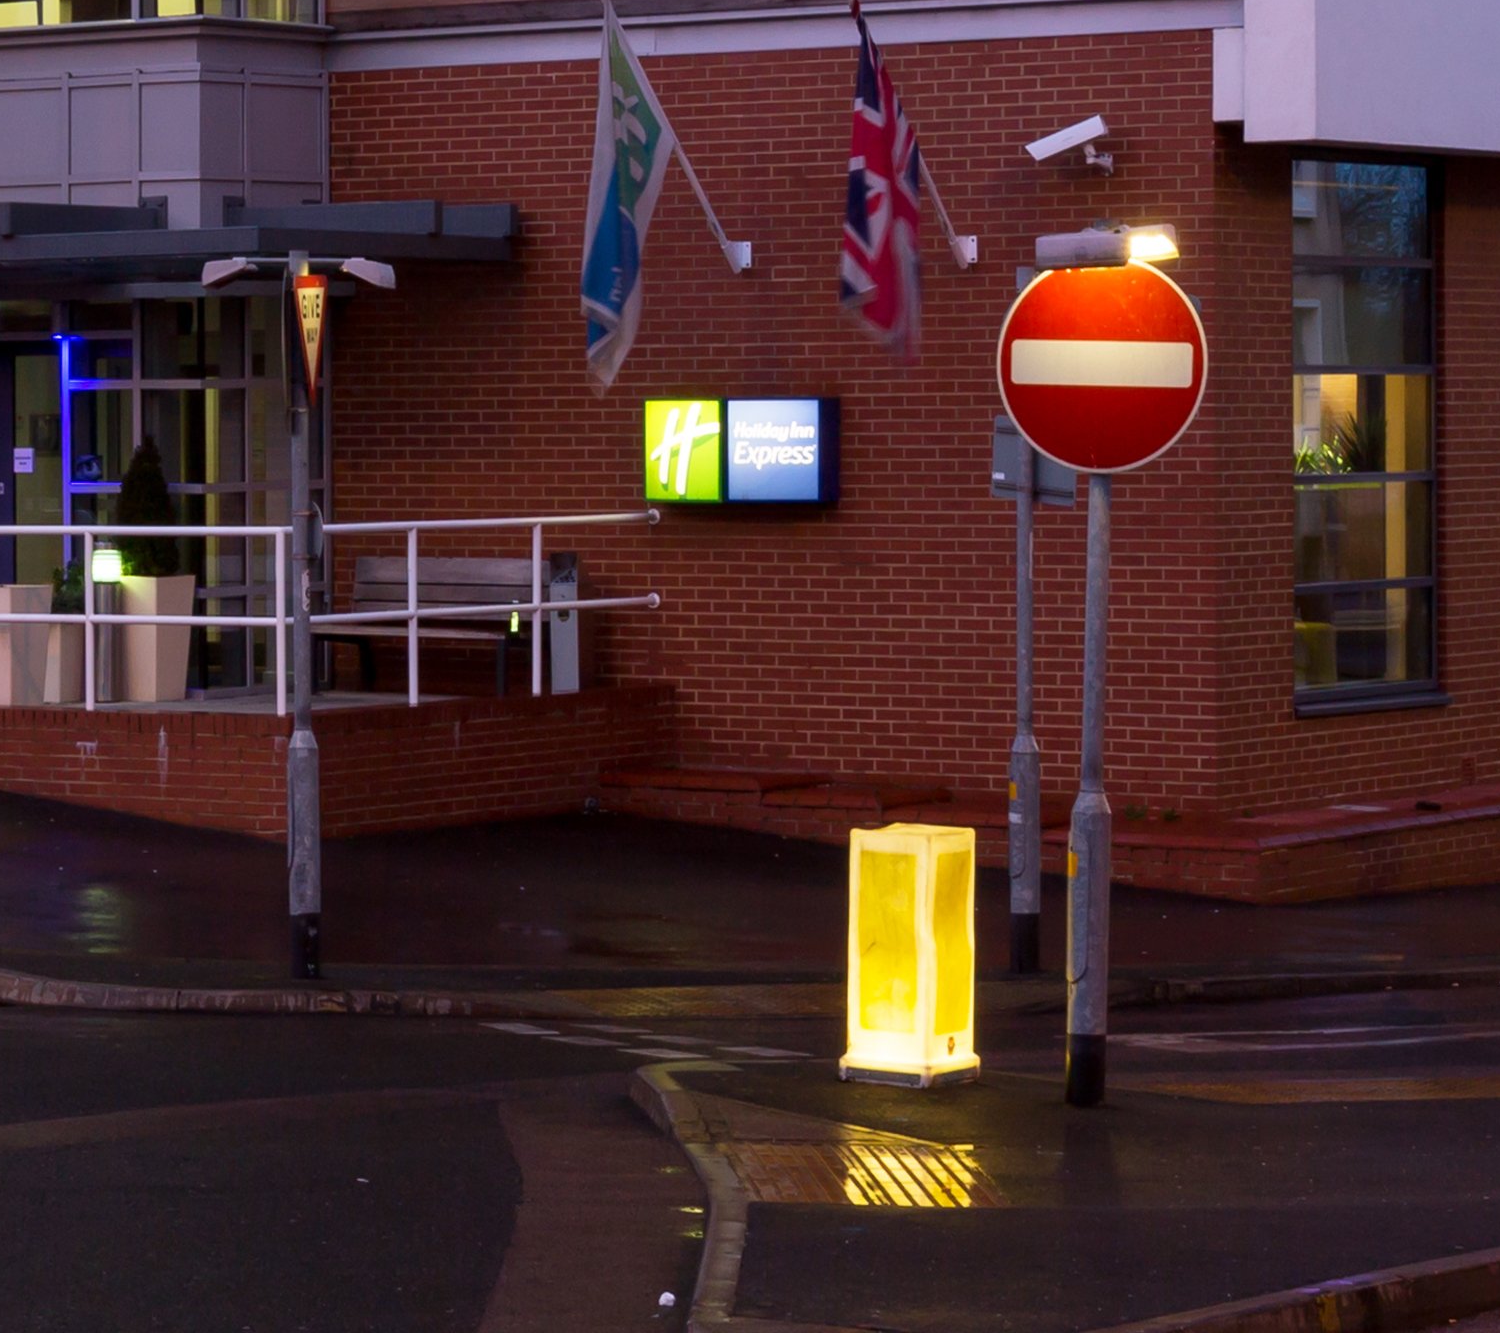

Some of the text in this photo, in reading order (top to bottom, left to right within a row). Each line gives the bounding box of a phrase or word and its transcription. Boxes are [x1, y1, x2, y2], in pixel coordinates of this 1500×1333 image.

[302, 293, 320, 320] GIVE
[306, 327, 318, 344] WAY
[733, 420, 816, 443] Holiday Inn
[733, 441, 816, 471] Express
